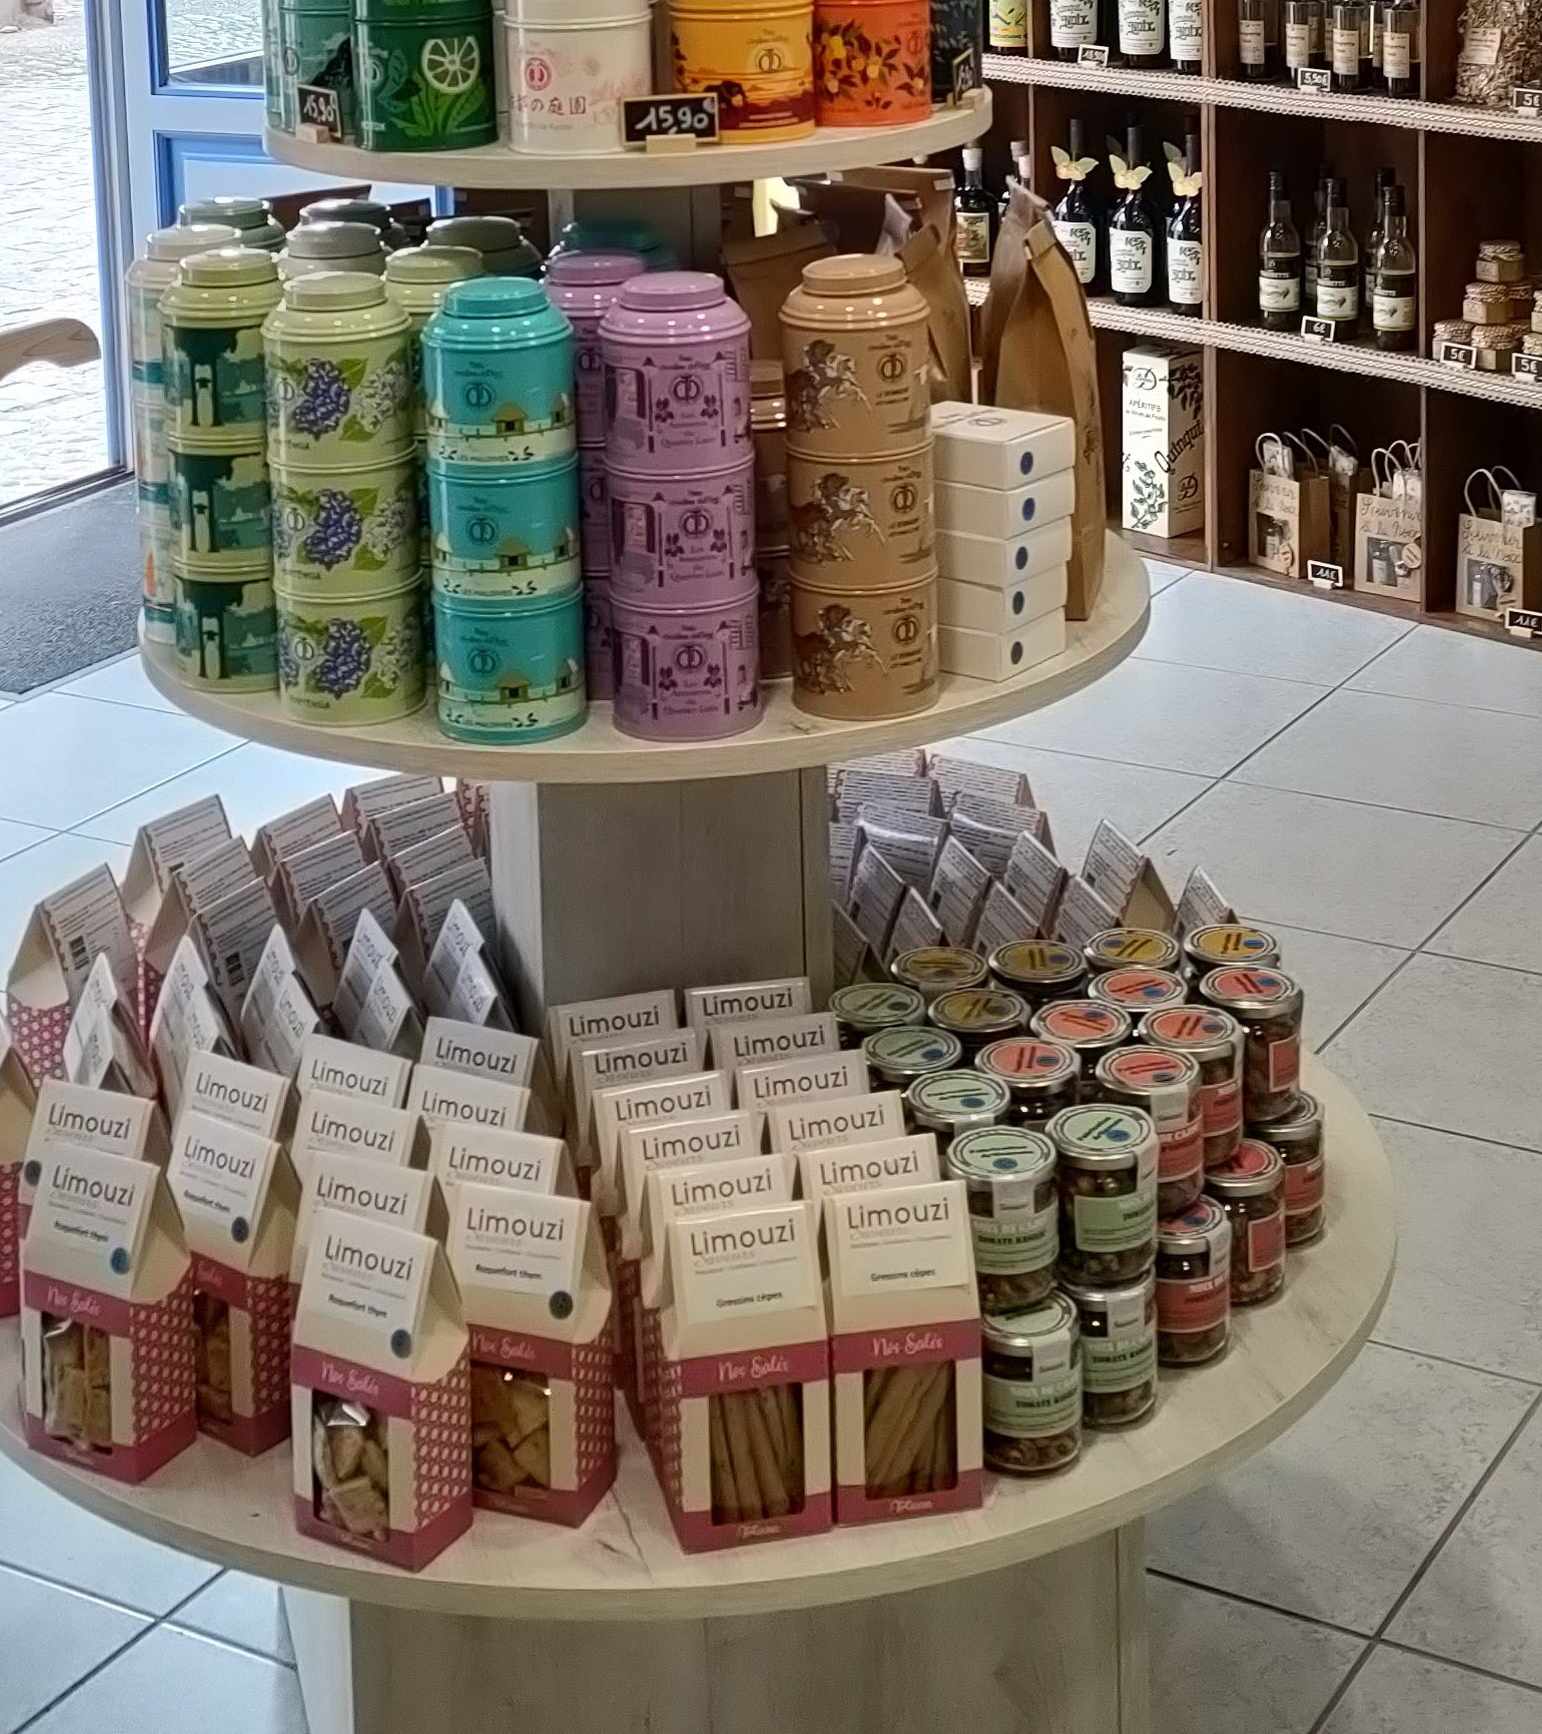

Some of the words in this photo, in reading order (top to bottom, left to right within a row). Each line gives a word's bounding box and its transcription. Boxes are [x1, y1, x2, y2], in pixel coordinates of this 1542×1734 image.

[1523, 93, 1541, 107] 5€
[1450, 348, 1465, 362] 5€
[1520, 359, 1538, 373] 5€
[702, 988, 793, 1017] Limouzi
[569, 1005, 660, 1038] Limouzi
[435, 1036, 517, 1075] Limouzi
[594, 1042, 688, 1074] Limouzi
[734, 1024, 826, 1057] Limouzi
[195, 1071, 270, 1114] Limouzi
[311, 1059, 388, 1096] Limouzi
[753, 1066, 849, 1099] Limouzi
[48, 1102, 132, 1141] Limouzi
[422, 1089, 507, 1128] Limouzi
[615, 1085, 712, 1122] Limouzi
[311, 1111, 395, 1153] Limouzi
[788, 1104, 885, 1141] Limouzi
[183, 1135, 255, 1179] Limouzi
[642, 1124, 740, 1160] Limouzi
[448, 1145, 541, 1183] Limouzi
[820, 1150, 919, 1186] Limouzi
[51, 1164, 134, 1208] Limouzi
[317, 1173, 408, 1216] Limouzi
[671, 1168, 773, 1207] Limouzi
[466, 1208, 564, 1242] Limouzi
[847, 1197, 950, 1230] Limouzi
[690, 1219, 796, 1256] Limouzi
[324, 1234, 414, 1282] Limouzi
